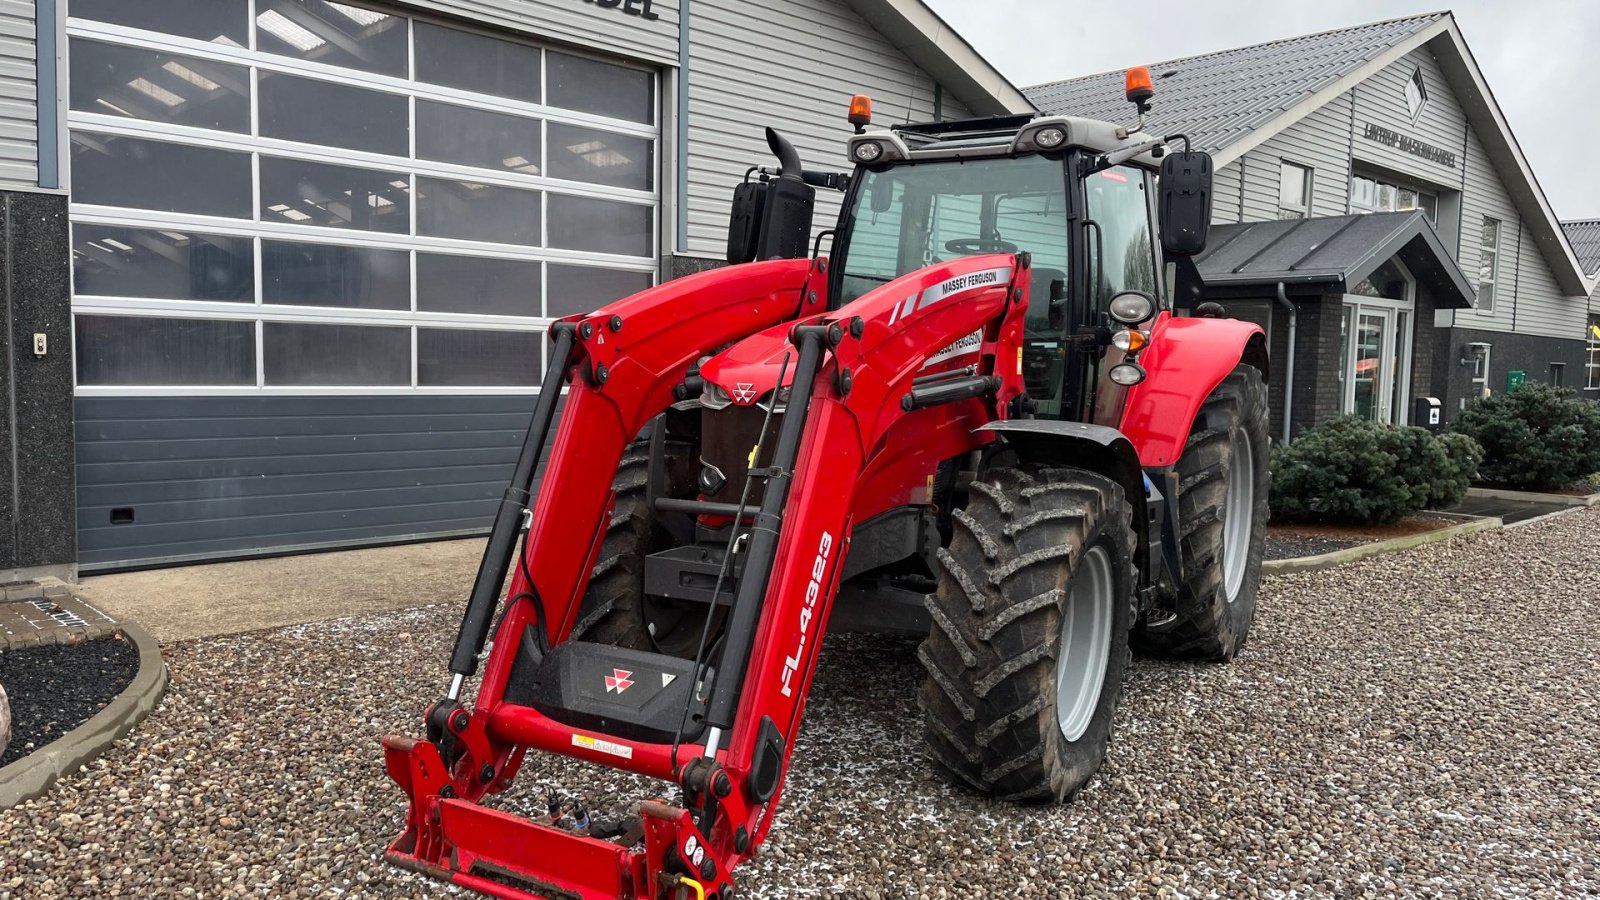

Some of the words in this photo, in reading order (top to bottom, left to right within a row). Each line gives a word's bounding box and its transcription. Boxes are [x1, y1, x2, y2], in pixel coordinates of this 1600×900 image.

[942, 276, 967, 295] MASSEY
[968, 271, 997, 287] FERGUSON
[780, 530, 833, 698] FL.4323
